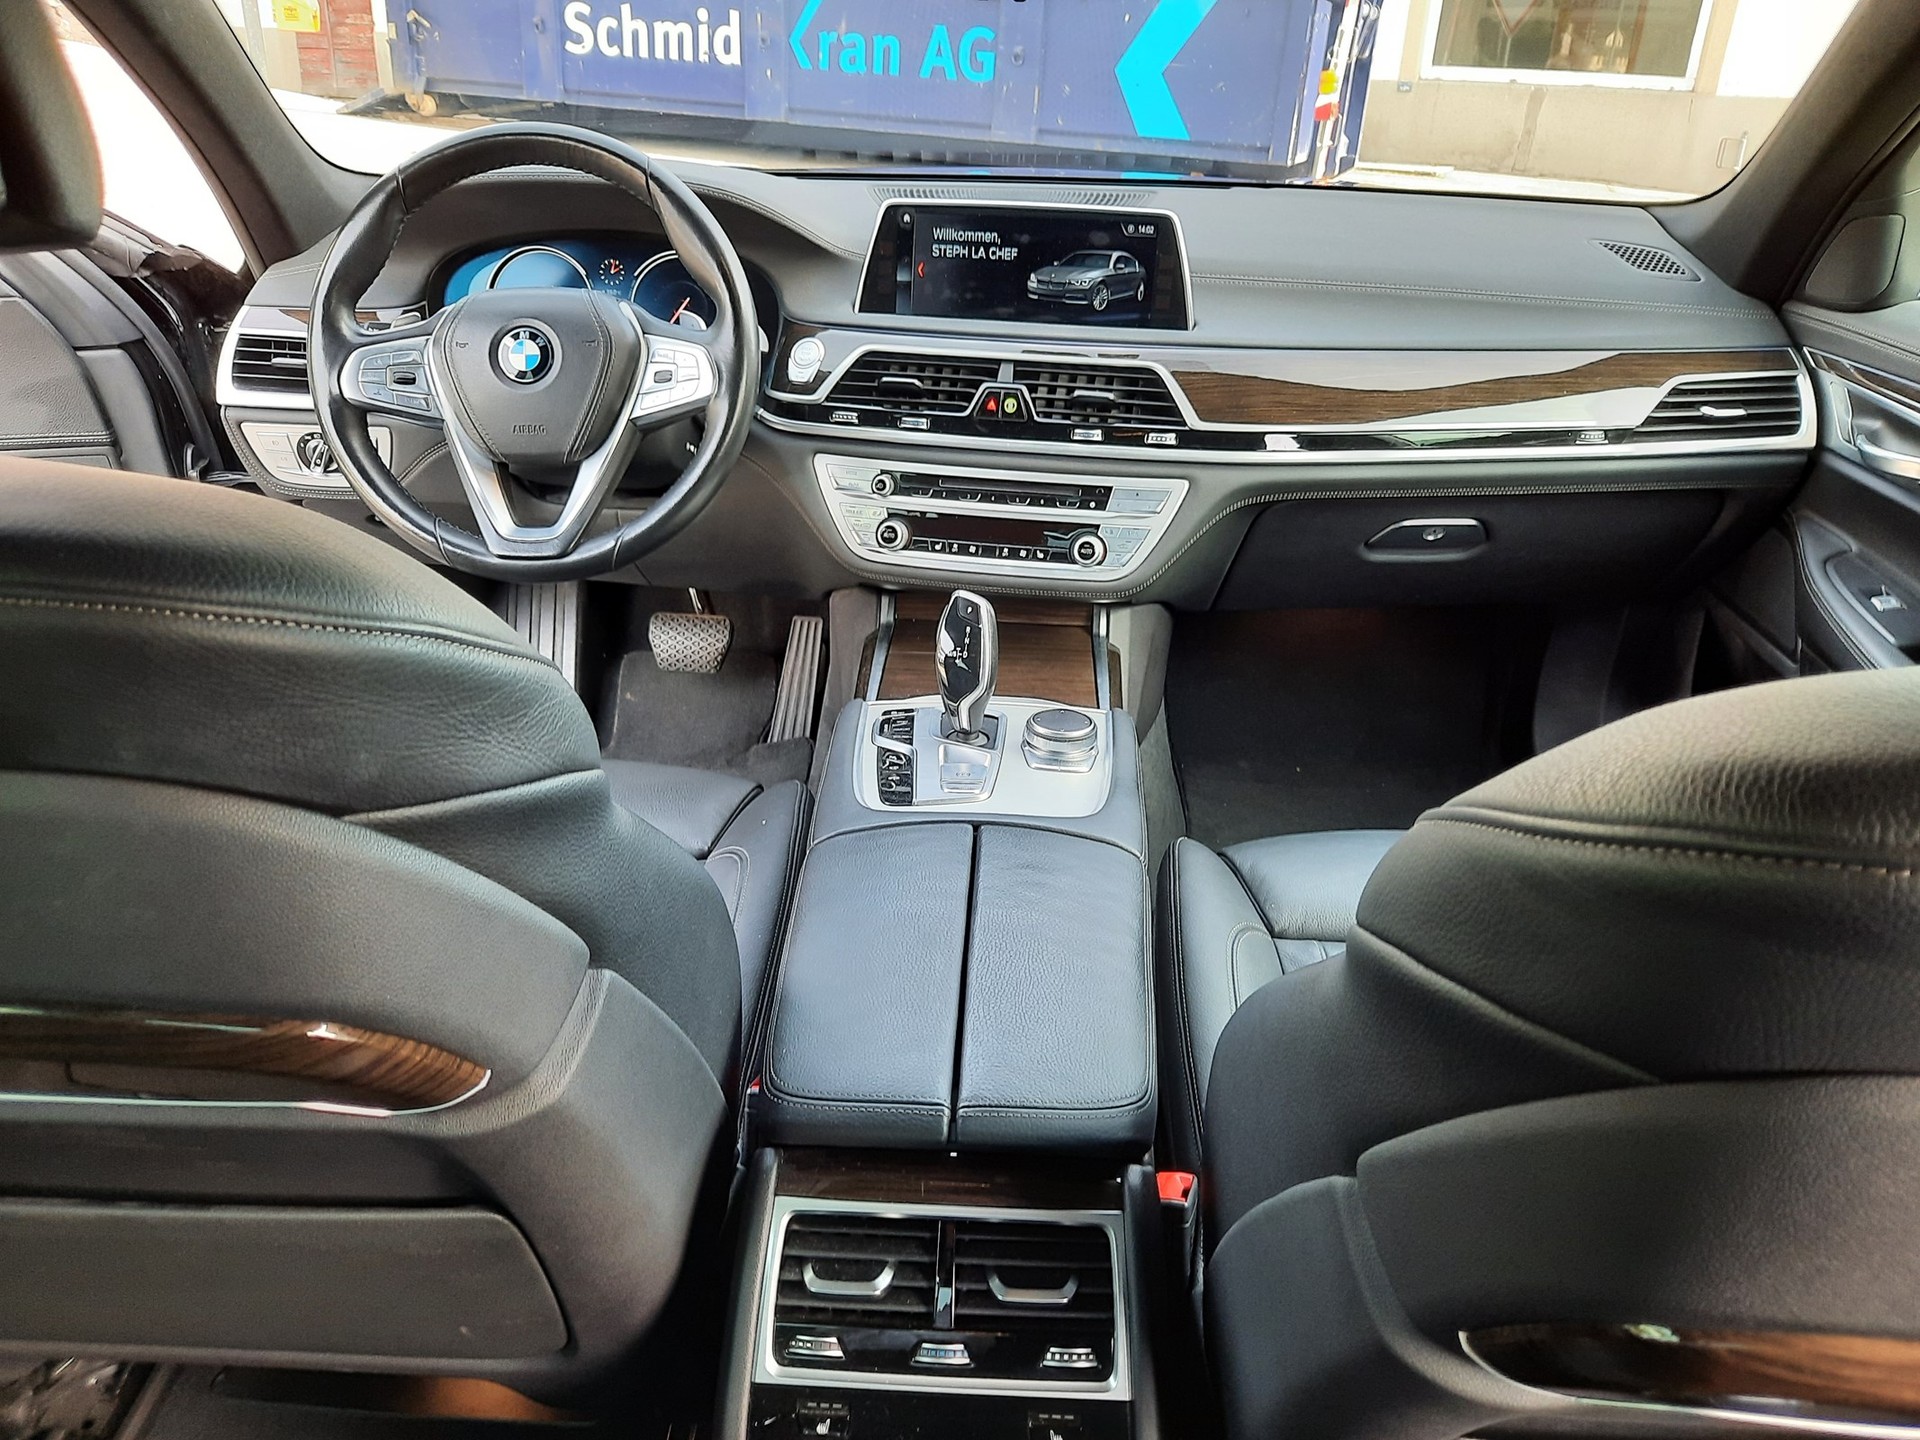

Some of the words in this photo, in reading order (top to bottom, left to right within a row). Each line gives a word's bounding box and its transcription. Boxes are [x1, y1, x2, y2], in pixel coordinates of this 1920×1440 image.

[563, 1, 741, 66] Schmid
[919, 24, 996, 83] AG
[932, 227, 1001, 245] Willkommen,
[932, 243, 968, 258] STEPH
[971, 246, 986, 259] LA
[989, 246, 1018, 261] CHEF
[512, 424, 546, 435] AIRBAG
